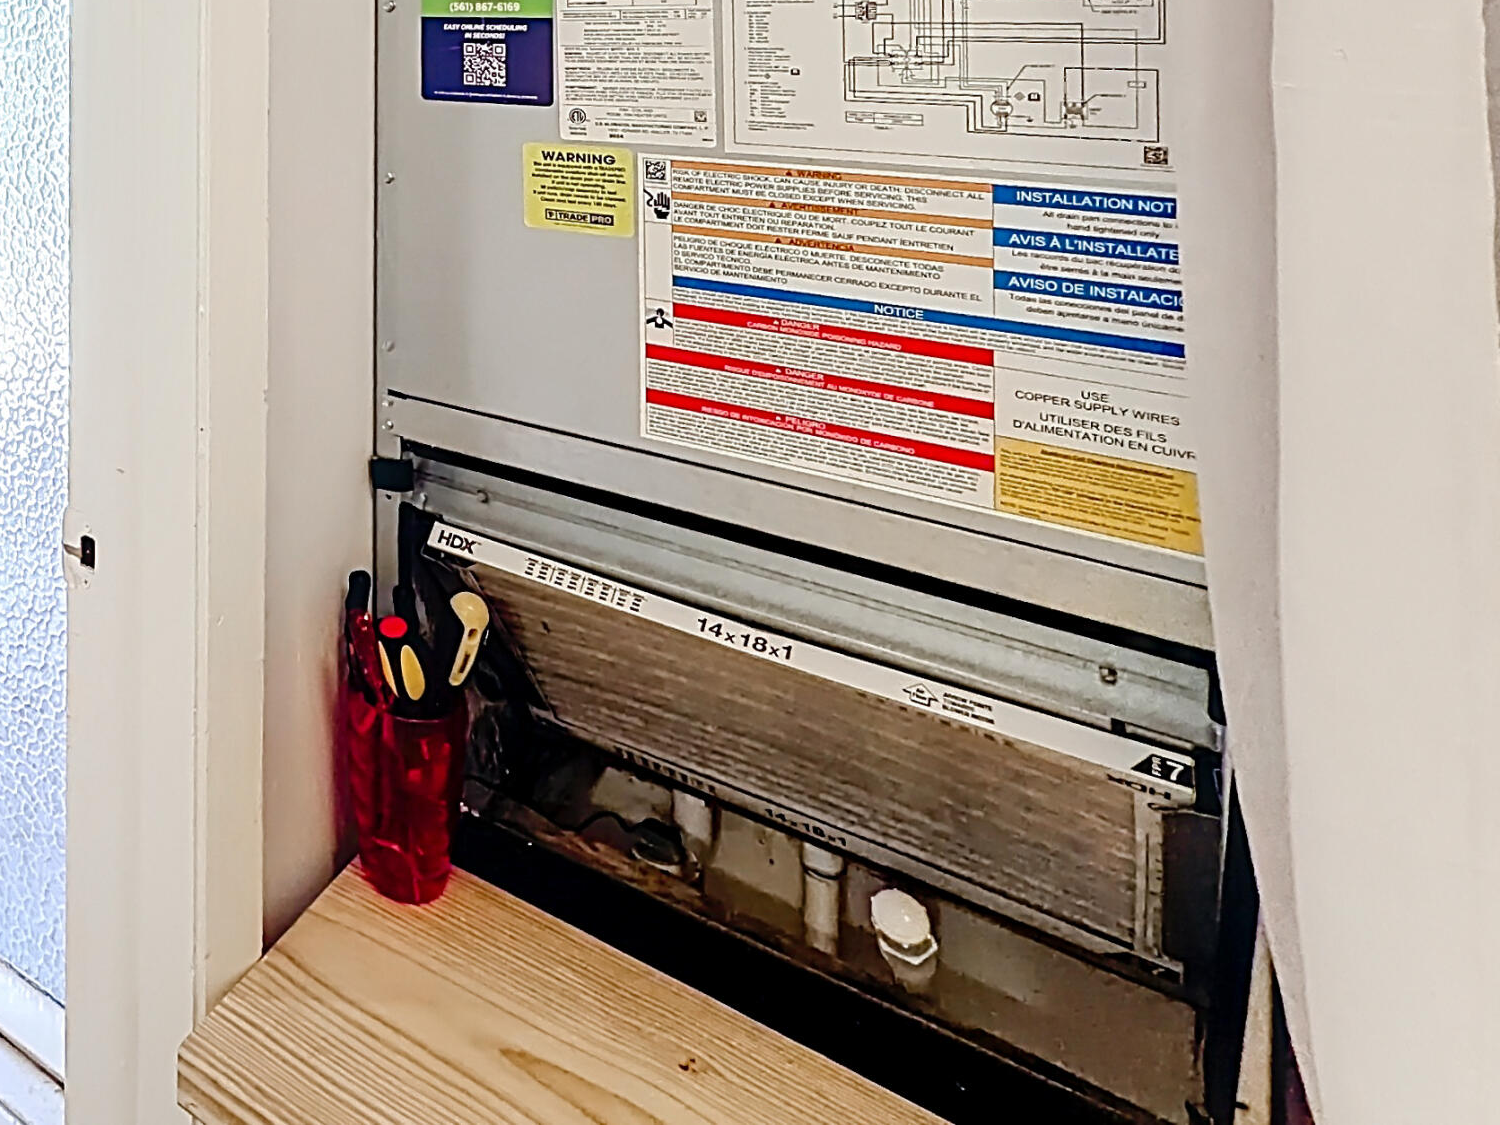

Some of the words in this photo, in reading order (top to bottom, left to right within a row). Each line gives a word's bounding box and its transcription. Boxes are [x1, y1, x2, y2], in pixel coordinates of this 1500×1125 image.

[449, 1, 473, 12] (561)
[475, 1, 521, 12] 867-6169
[541, 150, 616, 165] WARNING
[673, 176, 704, 184] REMOTE
[705, 178, 743, 188] ELECTRIC
[745, 181, 775, 190] POWER
[777, 184, 816, 194] SUPPLIES
[818, 187, 852, 197] BEFORE
[907, 194, 928, 203] THIS
[673, 183, 730, 194] COMPARTMENT
[732, 188, 754, 196] MUST
[768, 191, 801, 201] CLOSED
[803, 194, 836, 204] EXCEPT
[838, 197, 865, 206] WHEN
[703, 172, 741, 181] ELECTRIC
[774, 177, 791, 185] CAN
[792, 178, 820, 187] CAUSE
[823, 181, 854, 190] INJURY
[905, 187, 964, 199] DISCONNECT
[967, 191, 985, 200] ALL
[1016, 190, 1133, 210] INSTALLATION
[559, 212, 589, 222] TRADE
[591, 215, 612, 224] PRO
[673, 208, 698, 217] AVANT
[700, 211, 720, 219] TOUT
[722, 213, 765, 224] ENTRETIEN
[673, 201, 705, 210] DANGER
[718, 205, 741, 214] CHOC
[890, 222, 915, 231] TOUT
[929, 225, 975, 236] COURANT
[684, 216, 744, 229] COMPARTIMENT
[856, 233, 898, 245] PENDANT
[1008, 233, 1047, 247] AVIS
[822, 259, 850, 269] ANTES
[850, 255, 910, 268] DESCONECTE
[776, 269, 833, 283] PERMANECER
[834, 276, 877, 289] CERRADO
[923, 287, 968, 300] DURANTE
[1008, 276, 1058, 292] AVISO
[1062, 281, 1085, 295] DE
[874, 304, 925, 320] NOTICE
[780, 319, 821, 331] DANGER
[785, 368, 824, 381] DANGER
[1080, 390, 1110, 404] USE
[1014, 390, 1071, 407] COPPER
[1074, 400, 1129, 416] SUPPLY
[1132, 409, 1181, 426] WIRES
[786, 415, 826, 430] PELIGRO
[1039, 412, 1101, 431] UTILISER
[1103, 423, 1133, 437] DES
[1136, 429, 1168, 443] FILS
[1012, 419, 1125, 448] D'ALIMENTATION
[1128, 438, 1148, 452] EN
[437, 529, 476, 554] HDX
[697, 617, 794, 661] 14x18x1
[1151, 756, 1162, 777] FPR
[1166, 760, 1184, 781] 7
